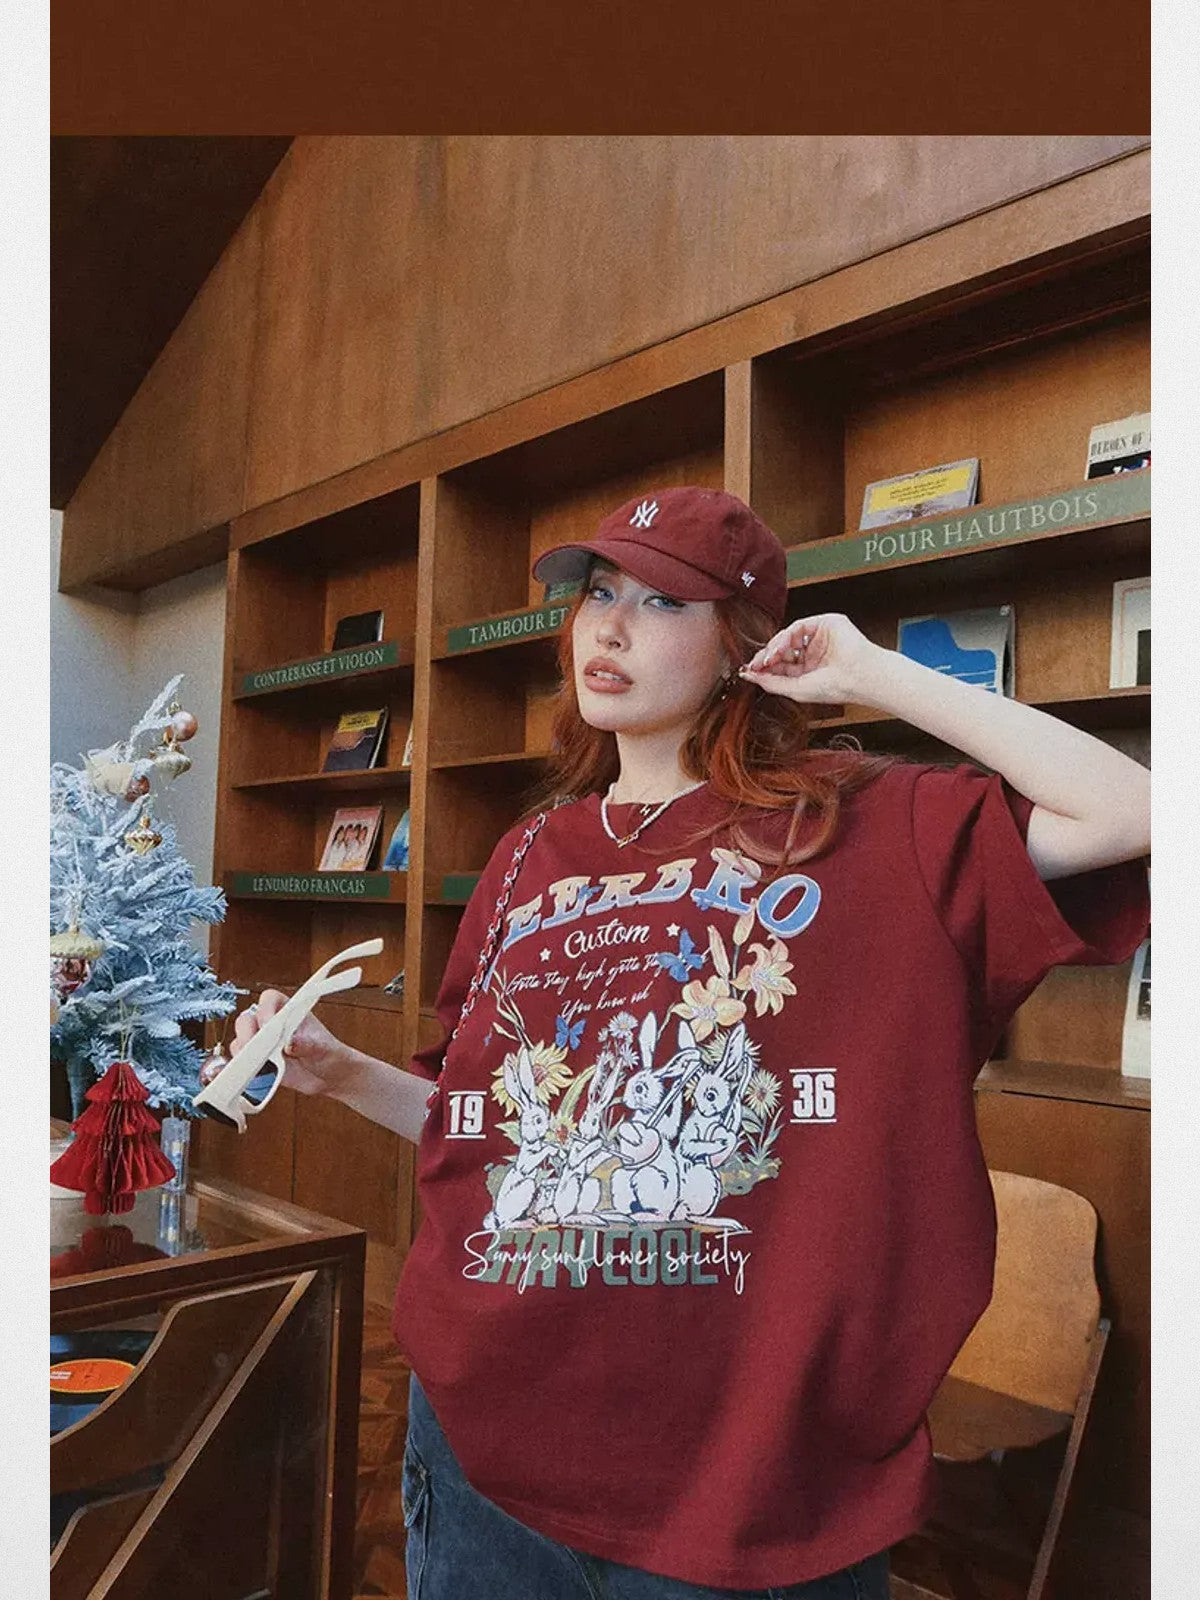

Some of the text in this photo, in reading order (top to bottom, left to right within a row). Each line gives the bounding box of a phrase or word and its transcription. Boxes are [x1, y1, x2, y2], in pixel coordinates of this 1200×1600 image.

[864, 492, 1099, 562] POUR HAUTBOIS
[469, 607, 569, 644] TAMBOUR ET
[338, 649, 385, 671] VIOLON
[564, 918, 651, 959] Custom
[576, 958, 607, 991] high
[449, 1095, 484, 1134] 19
[793, 1073, 835, 1118] 36
[541, 1229, 658, 1286] sunflower
[665, 1227, 753, 1295] society
[603, 1229, 719, 1286] COOL
